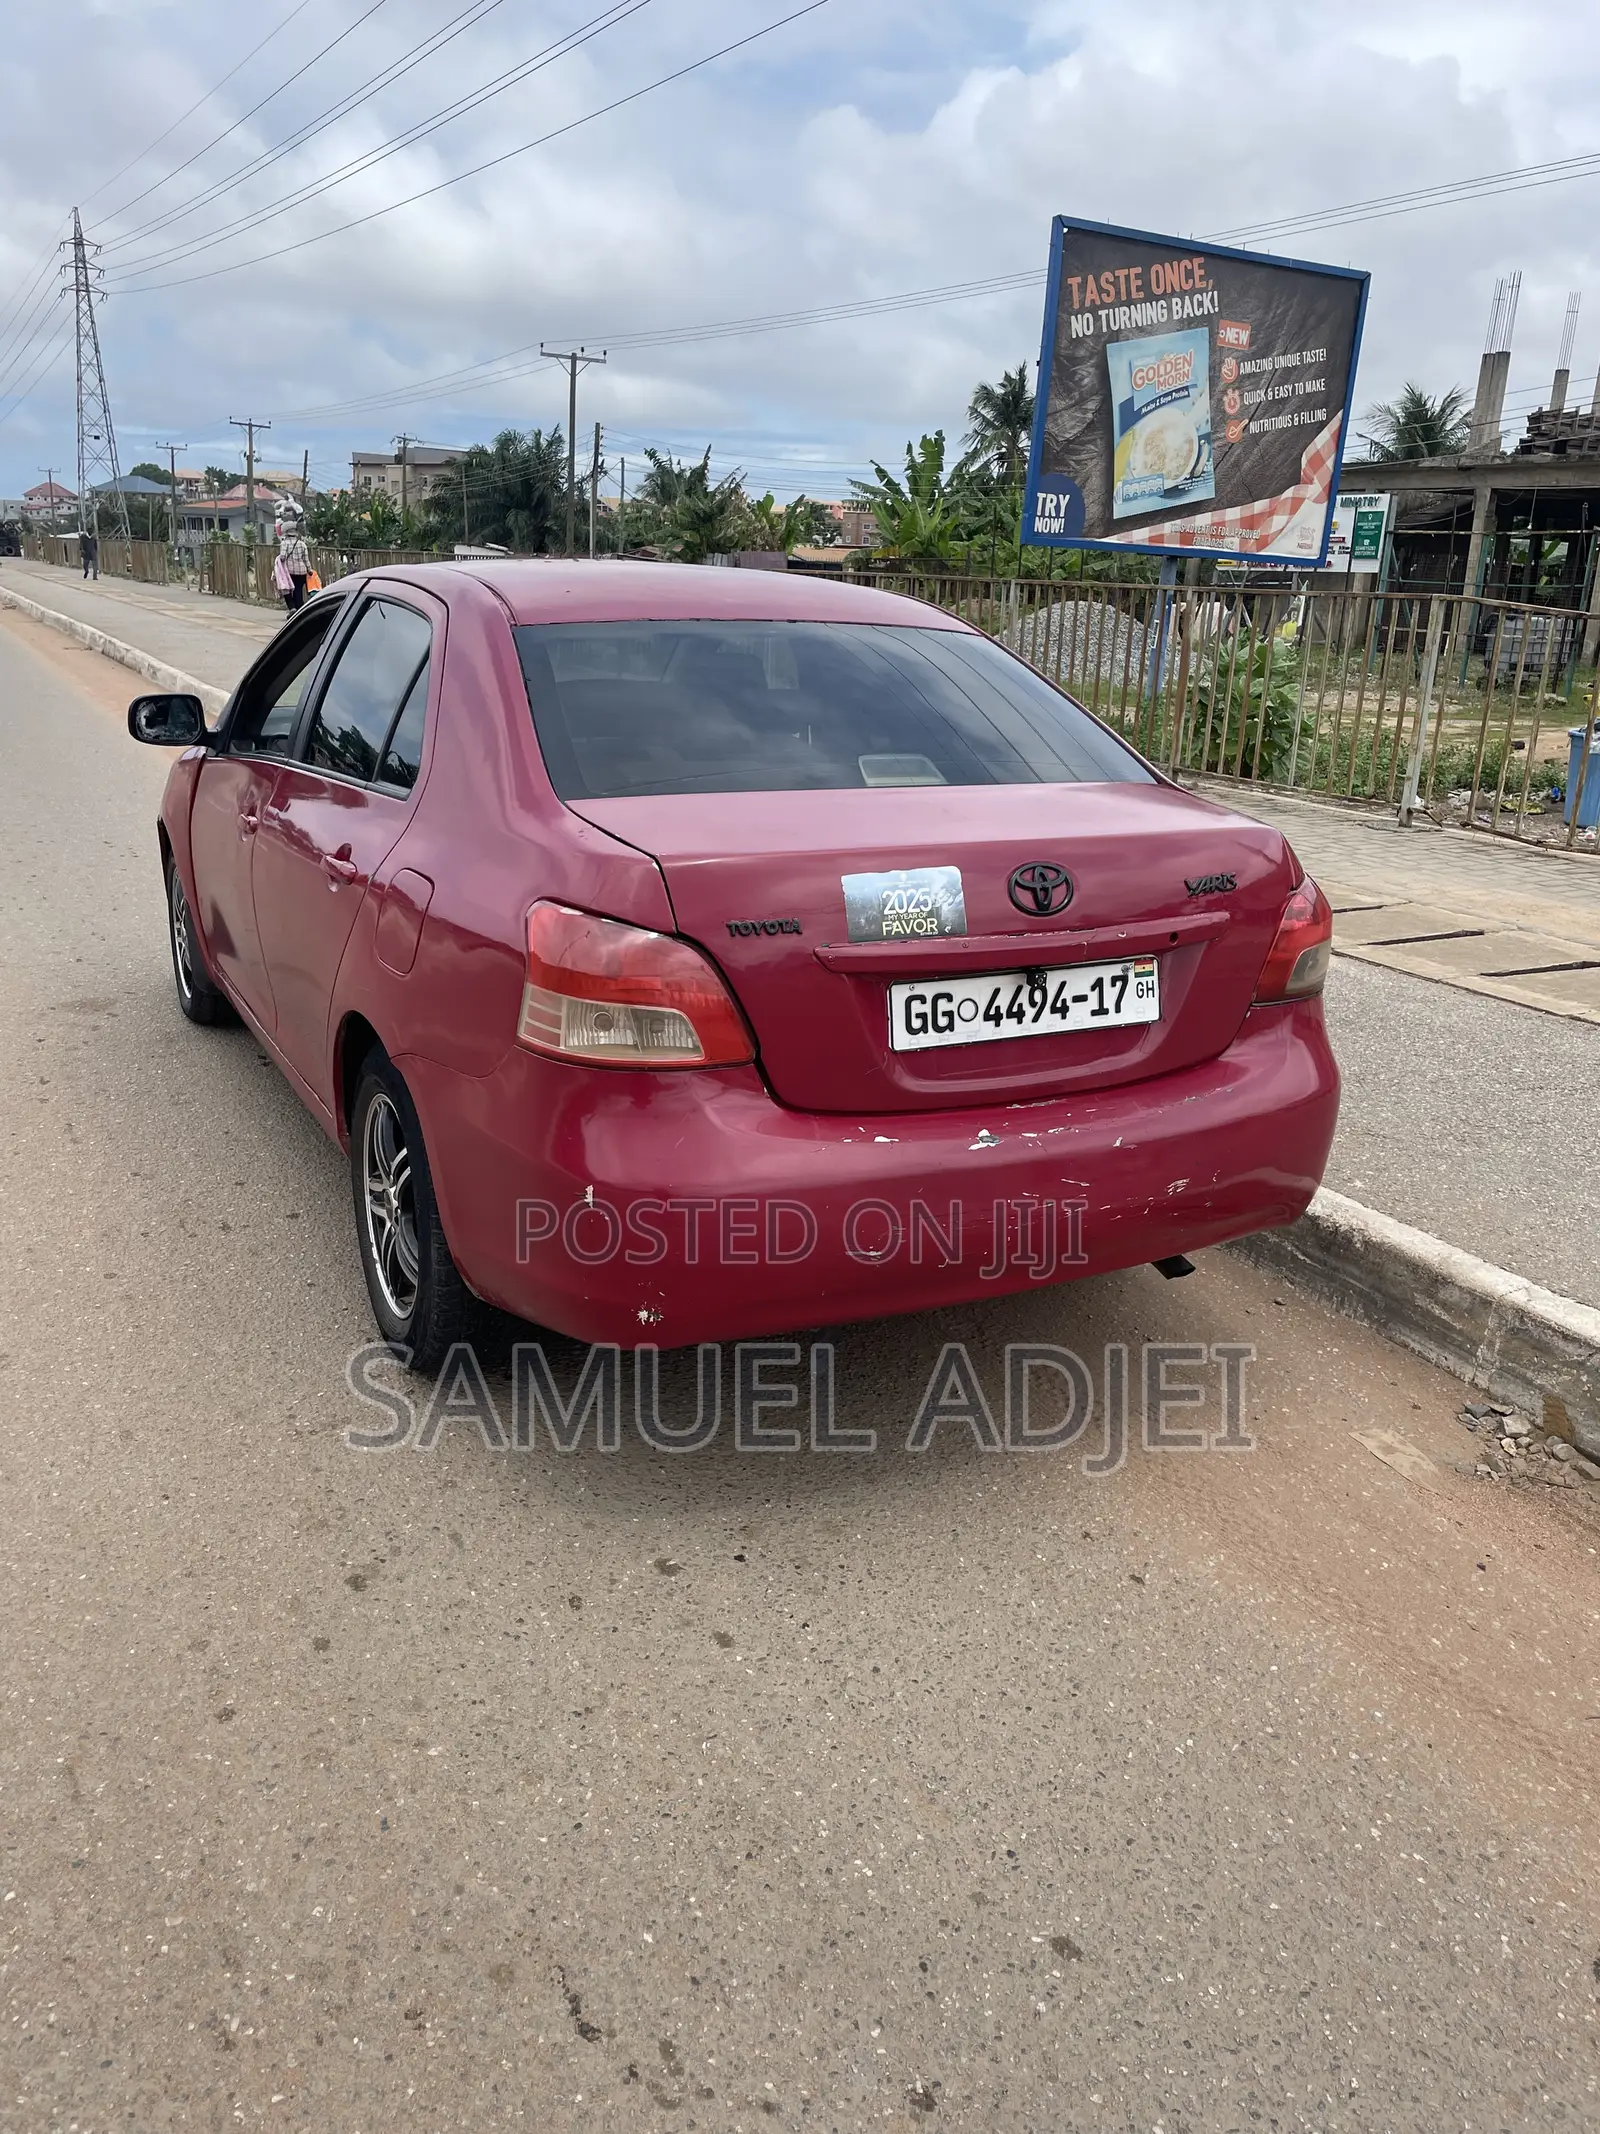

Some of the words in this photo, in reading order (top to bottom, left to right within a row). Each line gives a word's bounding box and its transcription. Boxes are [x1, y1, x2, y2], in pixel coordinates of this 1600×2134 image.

[1067, 266, 1145, 310] TASTE
[1150, 257, 1214, 295] ONCE,
[1070, 312, 1094, 339] NO
[1098, 299, 1168, 332] TURNING
[1171, 290, 1219, 320] BACK!
[1225, 327, 1249, 345] NEW
[1133, 350, 1193, 389] GOLDEN
[1240, 357, 1273, 375] AMAZING
[1274, 352, 1301, 370] UNIQUE
[1302, 348, 1327, 364] TASTE!
[1156, 369, 1191, 392] MORN
[1243, 389, 1266, 405] QUICK
[1267, 388, 1273, 400] &
[1274, 384, 1292, 399] EASY
[1294, 382, 1304, 395] TO
[1305, 378, 1326, 393] MAKE
[1249, 414, 1292, 434] NUTRITIOUS
[1293, 413, 1299, 425] &
[1300, 408, 1327, 425] FILLING
[1036, 492, 1070, 517] TRY
[1340, 496, 1380, 508] MINISTRY
[1034, 516, 1065, 534] NOW!
[1185, 524, 1209, 535] ADVERT
[1229, 528, 1261, 540] APPROVED
[881, 887, 932, 915] 2025
[726, 917, 803, 938] TOYOTA
[881, 918, 938, 936] FAVOR
[899, 912, 918, 920] YEAR
[918, 911, 929, 919] OF
[983, 974, 1130, 1028] 4494-17
[1135, 979, 1156, 999] GH
